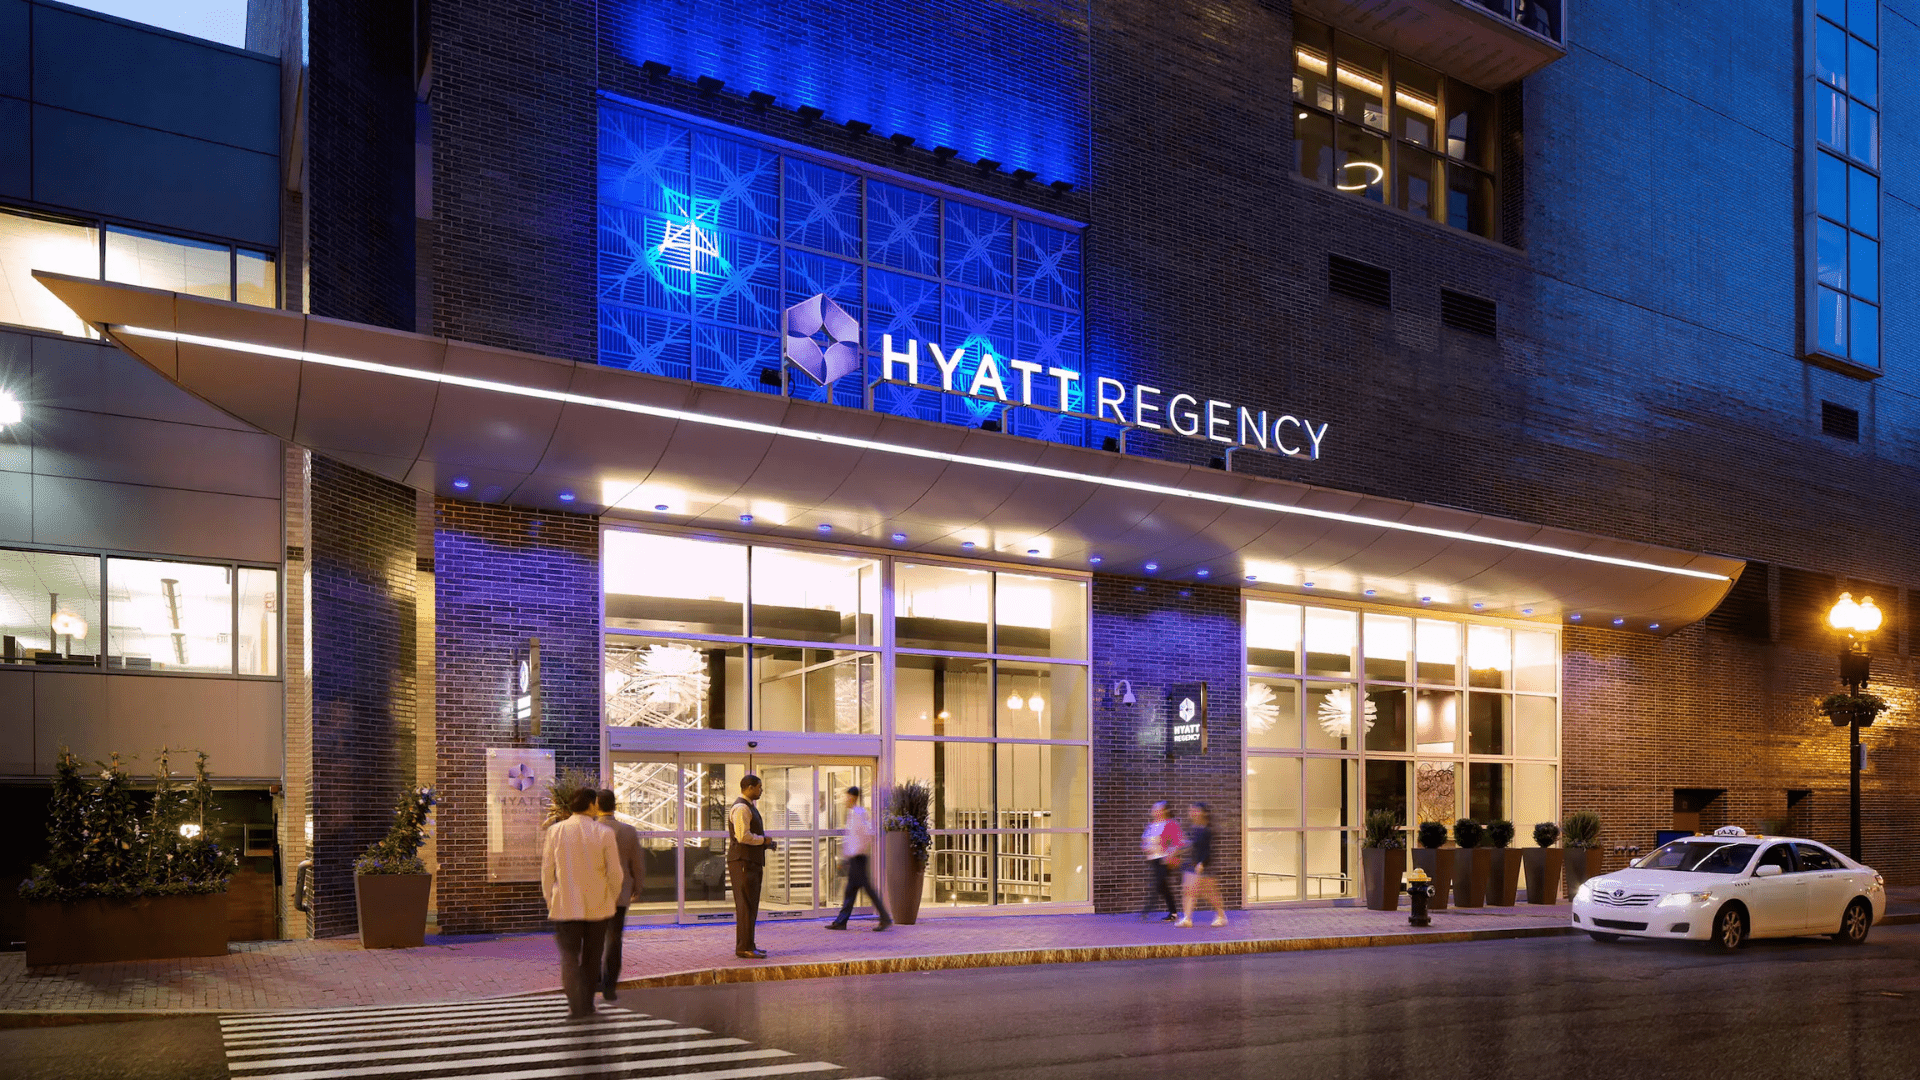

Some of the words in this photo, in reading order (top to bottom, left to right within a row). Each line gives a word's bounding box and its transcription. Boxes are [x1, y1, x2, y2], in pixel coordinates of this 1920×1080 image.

[881, 333, 1080, 412] HYATT
[1096, 376, 1329, 460] REGENCY
[1174, 724, 1200, 734] HYATT
[1174, 734, 1200, 742] REGENCY
